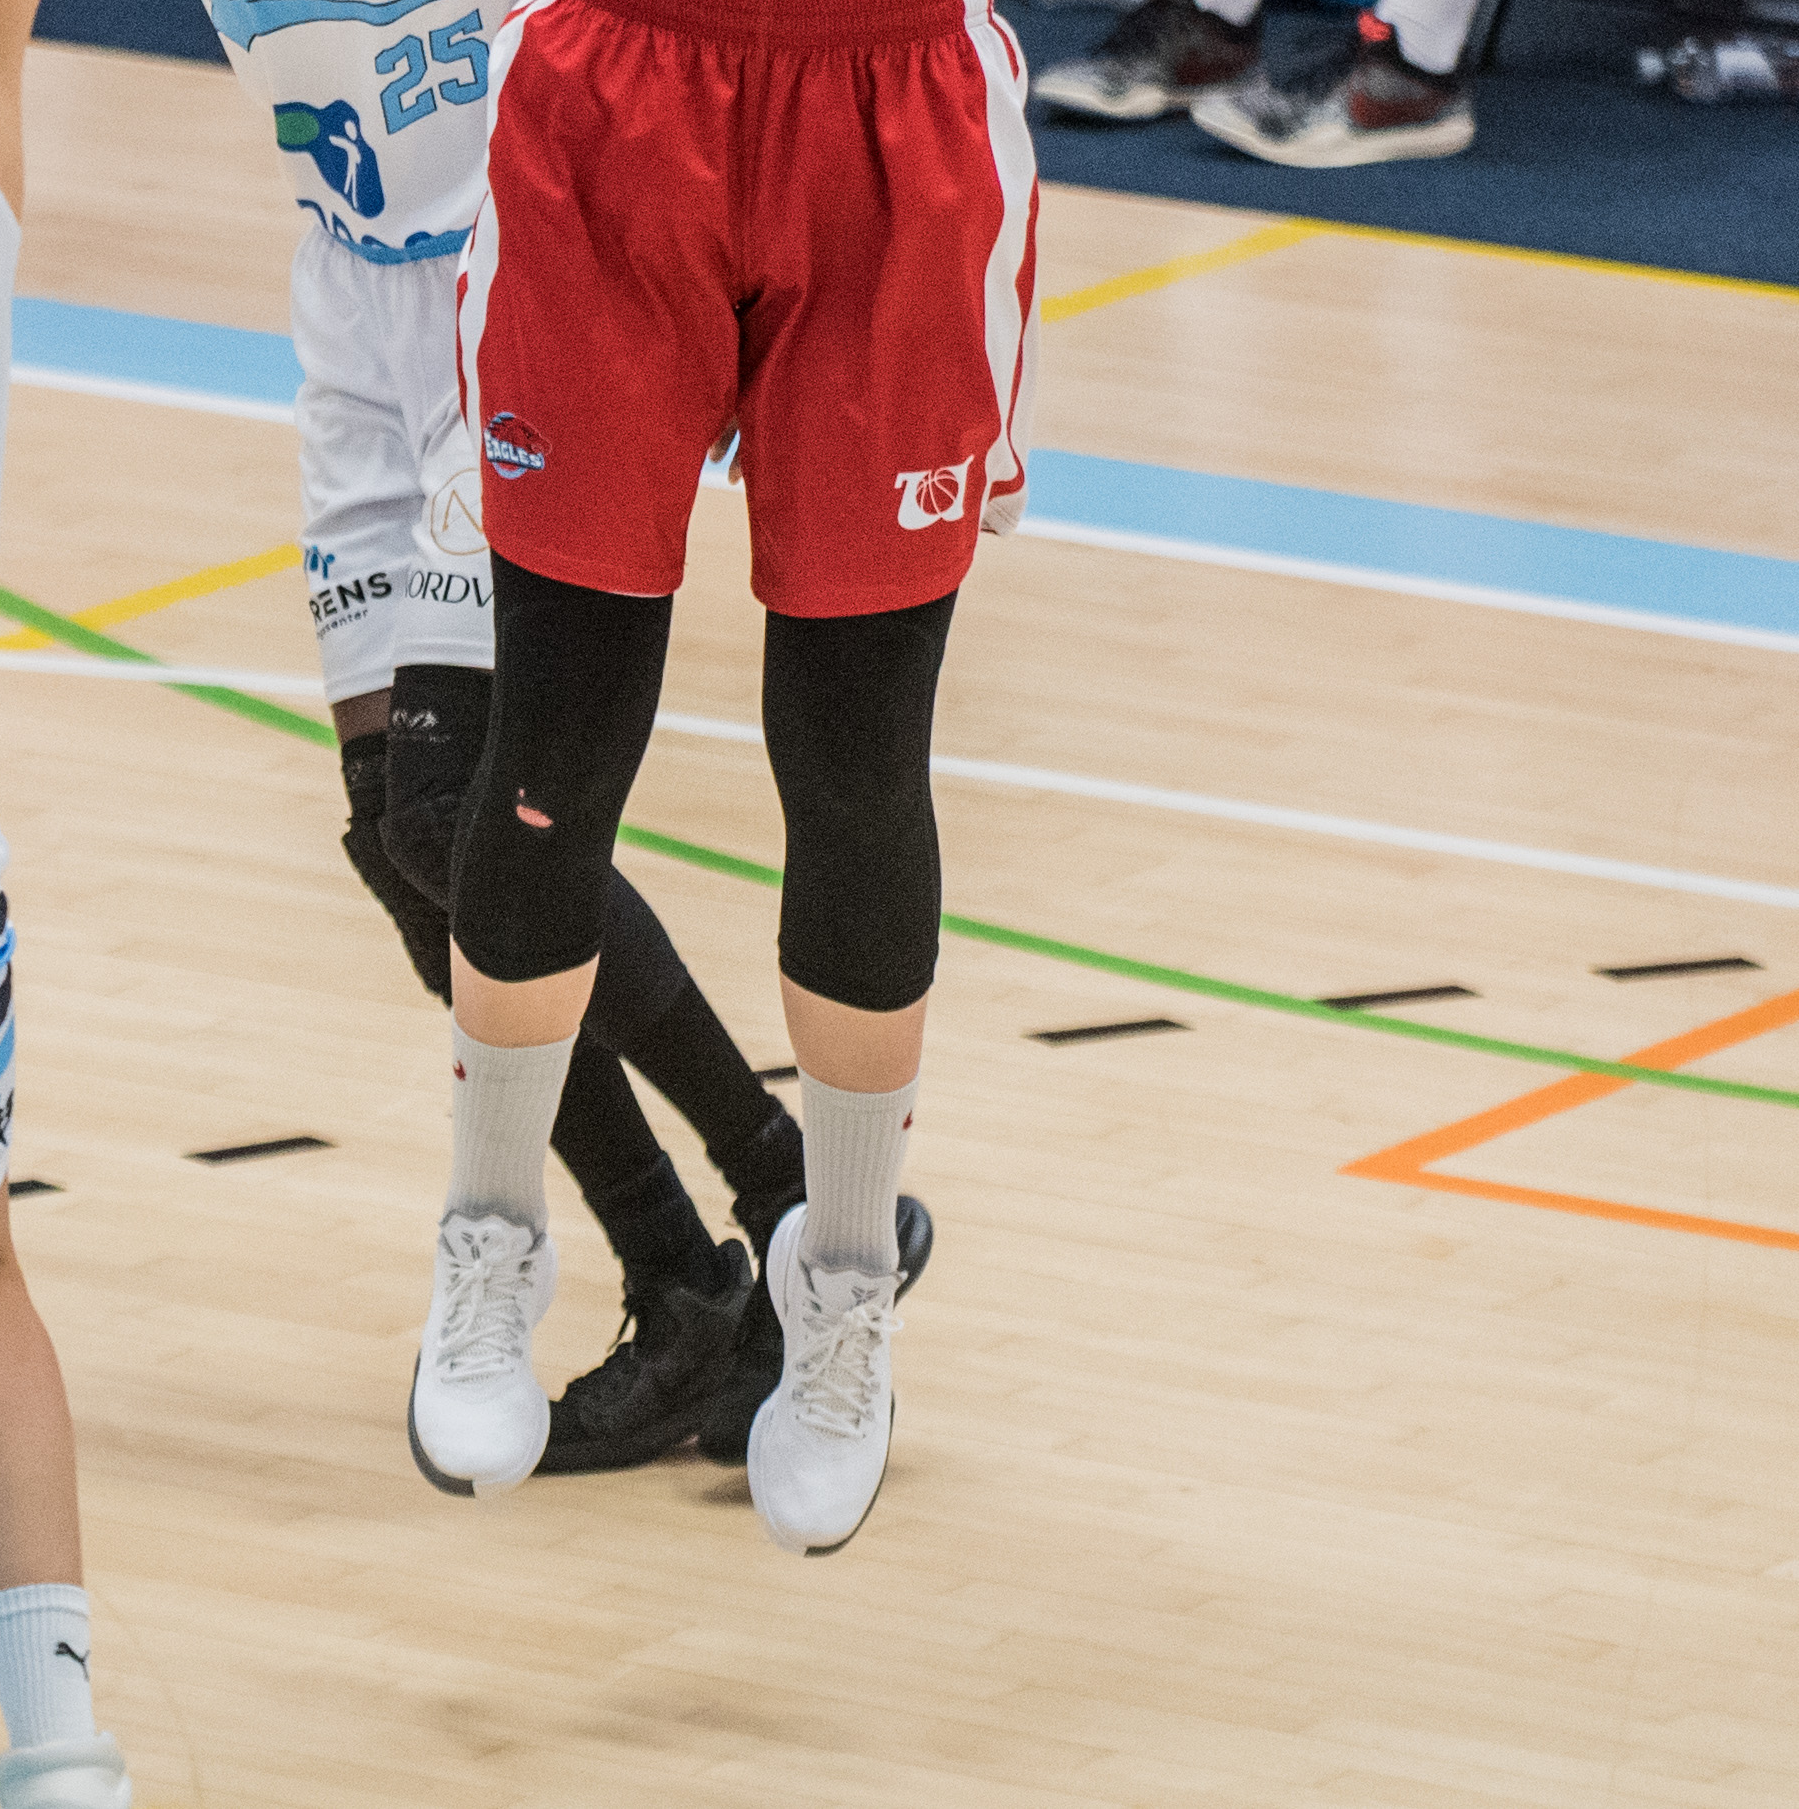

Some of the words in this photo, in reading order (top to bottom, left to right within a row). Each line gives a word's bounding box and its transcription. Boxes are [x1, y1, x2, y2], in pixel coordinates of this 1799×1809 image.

[374, 8, 491, 136] 25
[484, 428, 545, 470] EAGLES
[404, 569, 494, 608] ORDV
